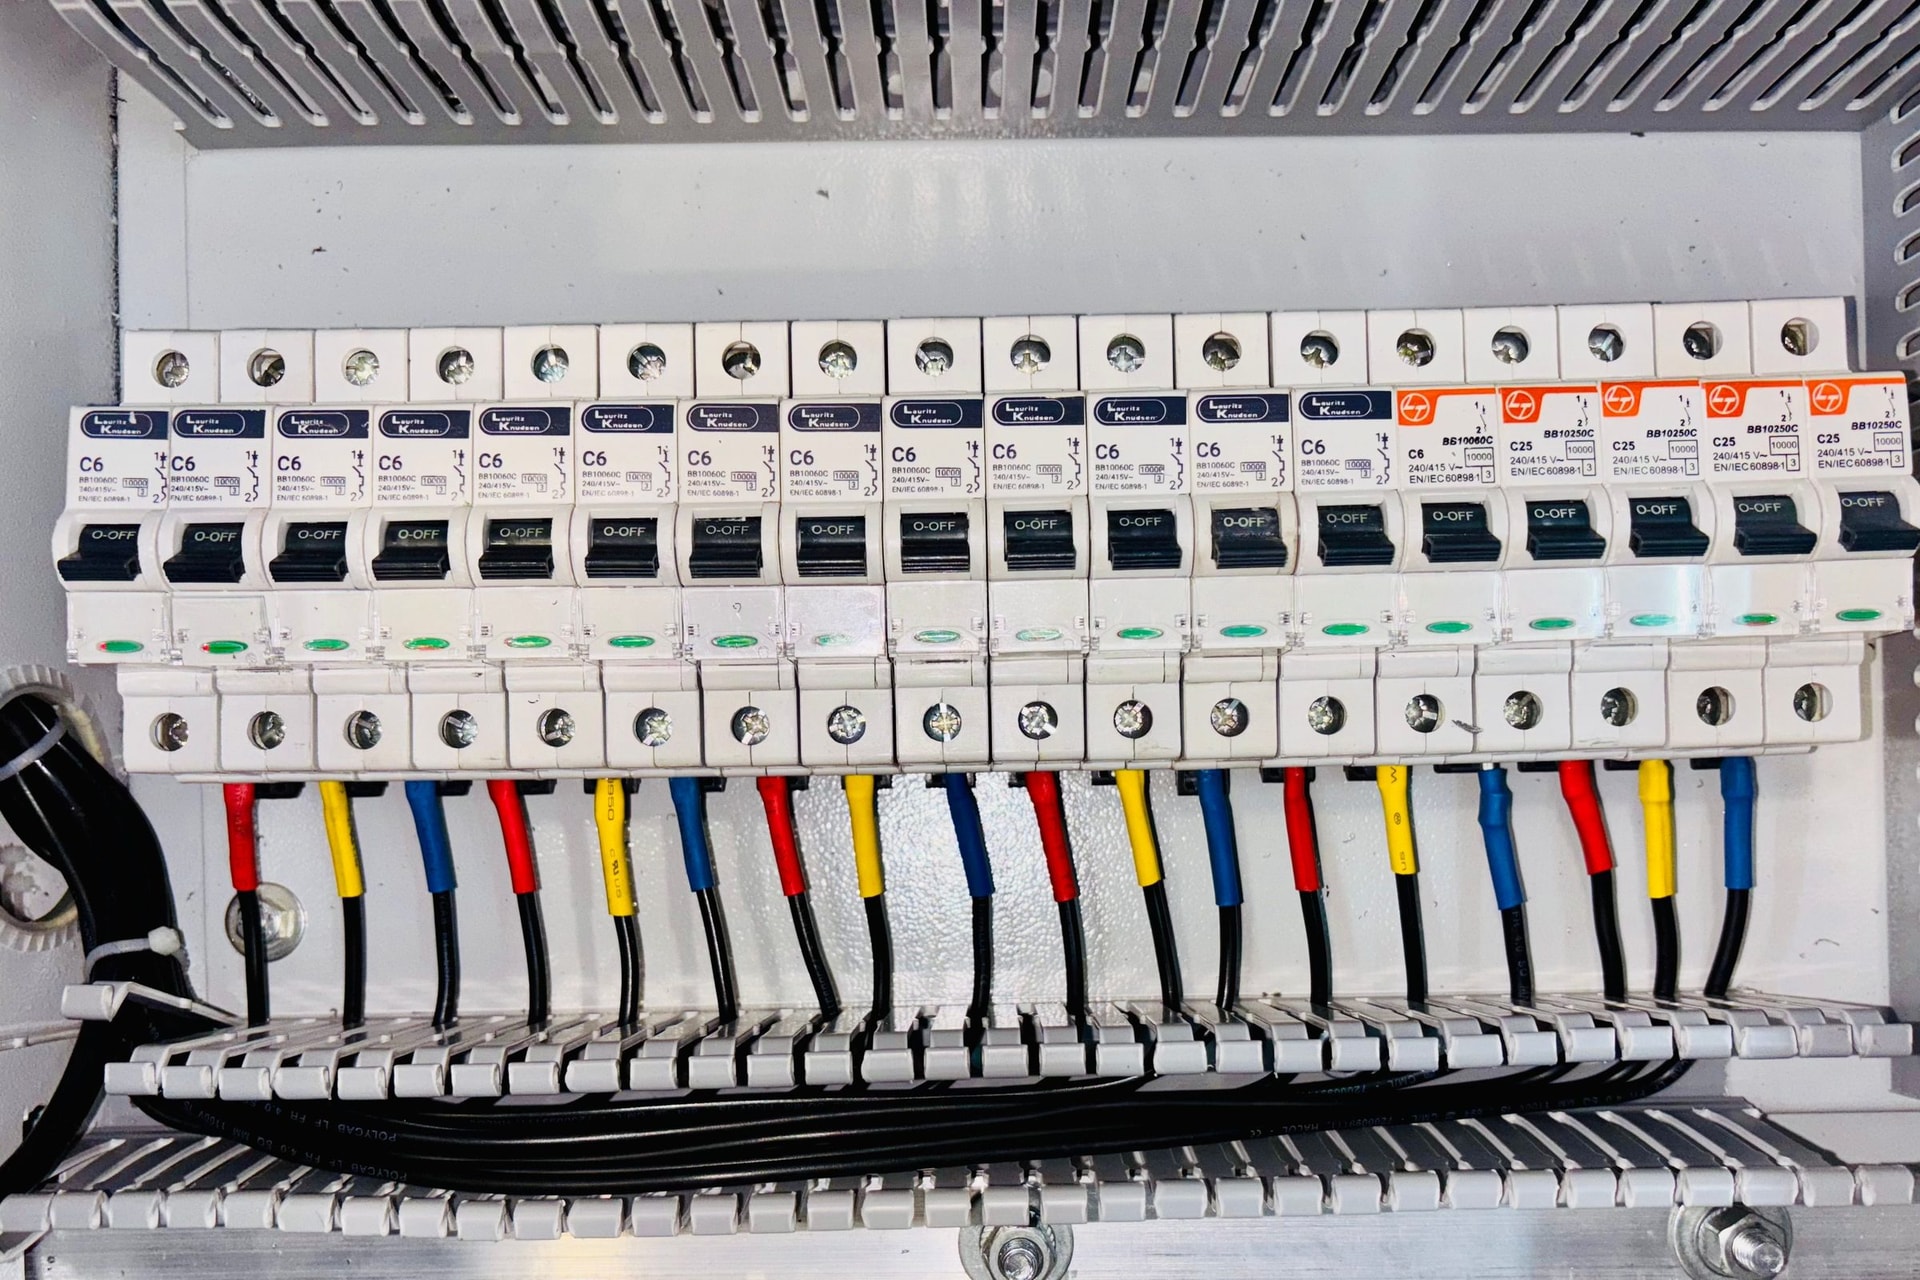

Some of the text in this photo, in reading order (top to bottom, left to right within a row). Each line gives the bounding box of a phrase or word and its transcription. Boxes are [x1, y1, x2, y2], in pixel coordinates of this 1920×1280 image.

[1217, 410, 1257, 419] Knudsen
[1320, 407, 1360, 416] Knudsen
[911, 415, 951, 424] Knudsen
[1013, 412, 1053, 422] Knudsen
[1114, 412, 1155, 421] Knudsen
[499, 422, 539, 431] Knudsen
[602, 420, 642, 429] Knudsen
[707, 419, 747, 428] Knudsen
[808, 419, 849, 428] Knudsen
[1851, 421, 1902, 429] BB10250C
[101, 426, 141, 435] Knudsen
[193, 425, 234, 434] Knudsen
[298, 425, 338, 434] Knudsen
[398, 425, 439, 434] Knudsen
[1646, 429, 1697, 437] BB10250C
[1747, 425, 1798, 433] BB10250C
[1544, 430, 1594, 438] BB10250C
[1713, 437, 1736, 447] C25
[1817, 434, 1840, 444] C25
[1876, 438, 1901, 446] 10000
[1196, 442, 1220, 457] C6
[1301, 439, 1325, 454] C6
[1510, 442, 1532, 451] C25
[1568, 446, 1593, 454] 10000
[1612, 441, 1635, 451] C25
[1671, 446, 1696, 454] 10000
[1772, 441, 1797, 450] 10000
[892, 447, 916, 462] C6
[993, 444, 1017, 459] C6
[1095, 444, 1119, 459] C6
[1408, 449, 1424, 460] C6
[1713, 452, 1750, 460] 240/415
[1818, 448, 1854, 457] 240/415
[479, 453, 503, 468] C6
[583, 451, 607, 466] C6
[688, 450, 712, 465] C6
[790, 450, 814, 465] C6
[1467, 453, 1492, 461] 10000
[1510, 456, 1547, 465] 240/415
[1612, 456, 1650, 464] 240/415
[1895, 454, 1901, 464] 3
[80, 457, 104, 472] C6
[171, 456, 195, 471] C6
[277, 456, 301, 471] C6
[379, 455, 403, 470] C6
[1689, 462, 1696, 472] 3
[1790, 458, 1796, 468] 3
[1408, 464, 1446, 472] 240/415
[1586, 463, 1592, 472] 3
[1485, 470, 1492, 480] 3
[291, 1111, 306, 1123] FR
[316, 1119, 329, 1128] LF
[338, 1124, 397, 1142] POLYCAB
[352, 1163, 407, 1181] POLYCAB
